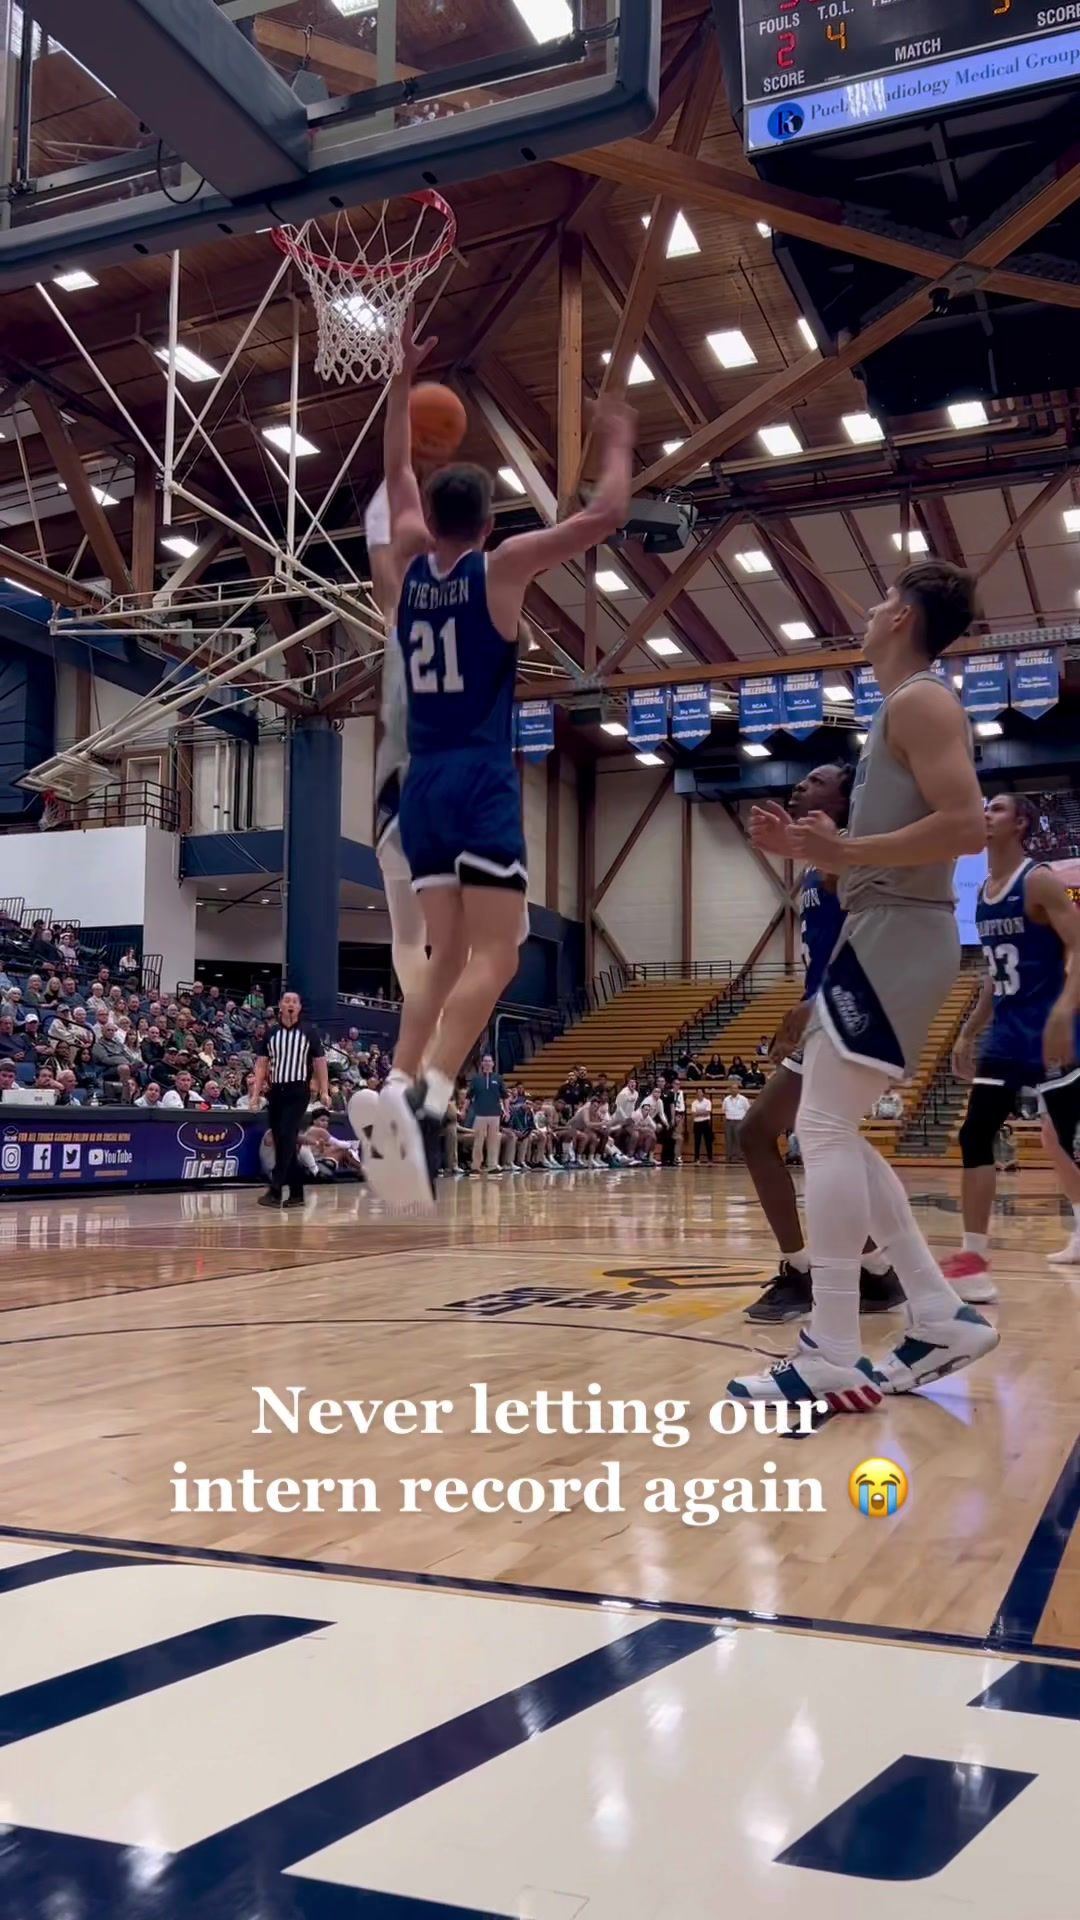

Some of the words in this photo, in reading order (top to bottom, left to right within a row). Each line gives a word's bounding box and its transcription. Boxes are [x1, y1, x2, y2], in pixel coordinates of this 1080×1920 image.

[817, 1, 855, 20] T.O.L.
[759, 12, 800, 36] FOULS
[825, 21, 848, 50] 4
[776, 32, 797, 67] 2
[894, 37, 941, 62] MATCH
[956, 56, 1019, 86] Medical
[1026, 48, 1080, 70] Group
[763, 70, 806, 92] SCORE
[409, 616, 465, 693] 21
[103, 1149, 133, 1164] YouTube
[184, 1159, 237, 1179] UCSB
